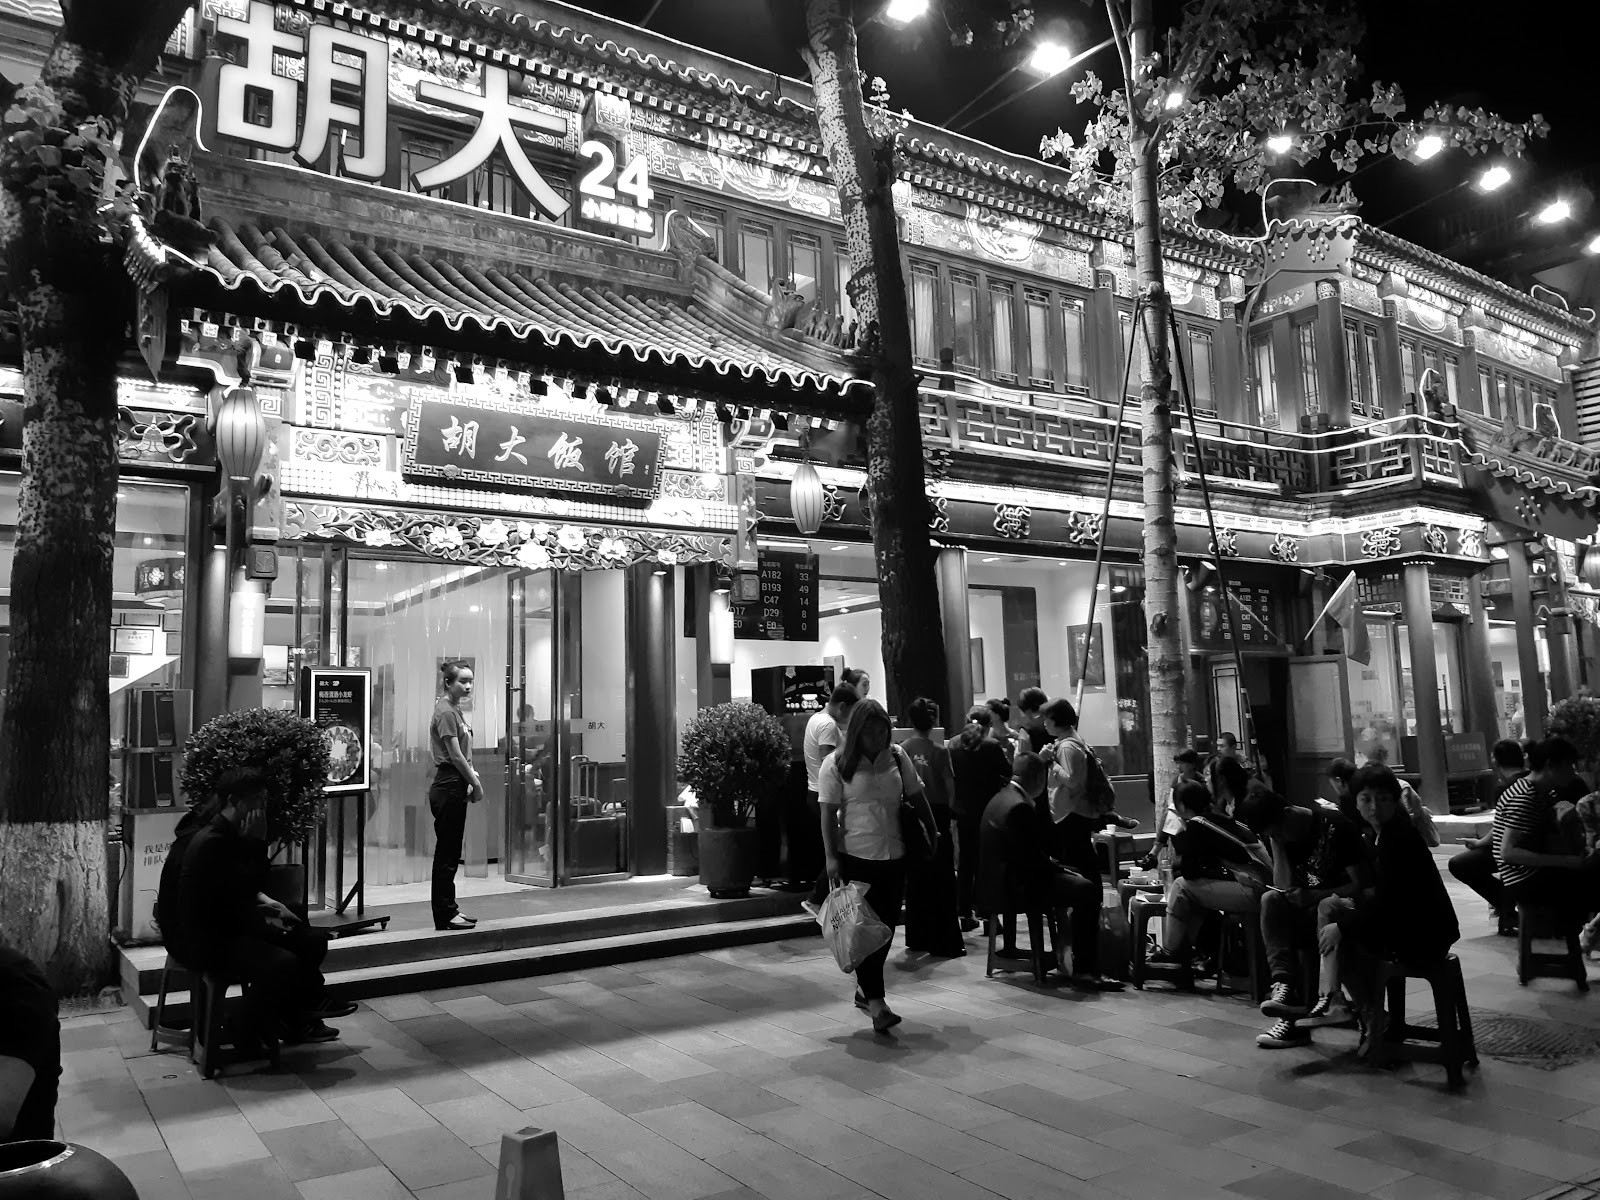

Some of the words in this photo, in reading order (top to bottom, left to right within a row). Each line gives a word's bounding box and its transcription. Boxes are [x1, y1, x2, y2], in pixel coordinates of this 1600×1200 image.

[217, 0, 572, 221] 胡大
[580, 140, 654, 208] 24
[440, 415, 639, 478] 胡大饭馆
[761, 570, 782, 580] A182
[799, 572, 809, 581] 33
[761, 582, 782, 592] B193
[799, 585, 809, 594] 49
[763, 595, 780, 605] C47
[799, 597, 809, 606] 14
[763, 607, 780, 617] D29
[801, 610, 807, 619] 8
[766, 620, 777, 630] E0
[801, 622, 807, 631] 0
[587, 721, 606, 730] 胡大
